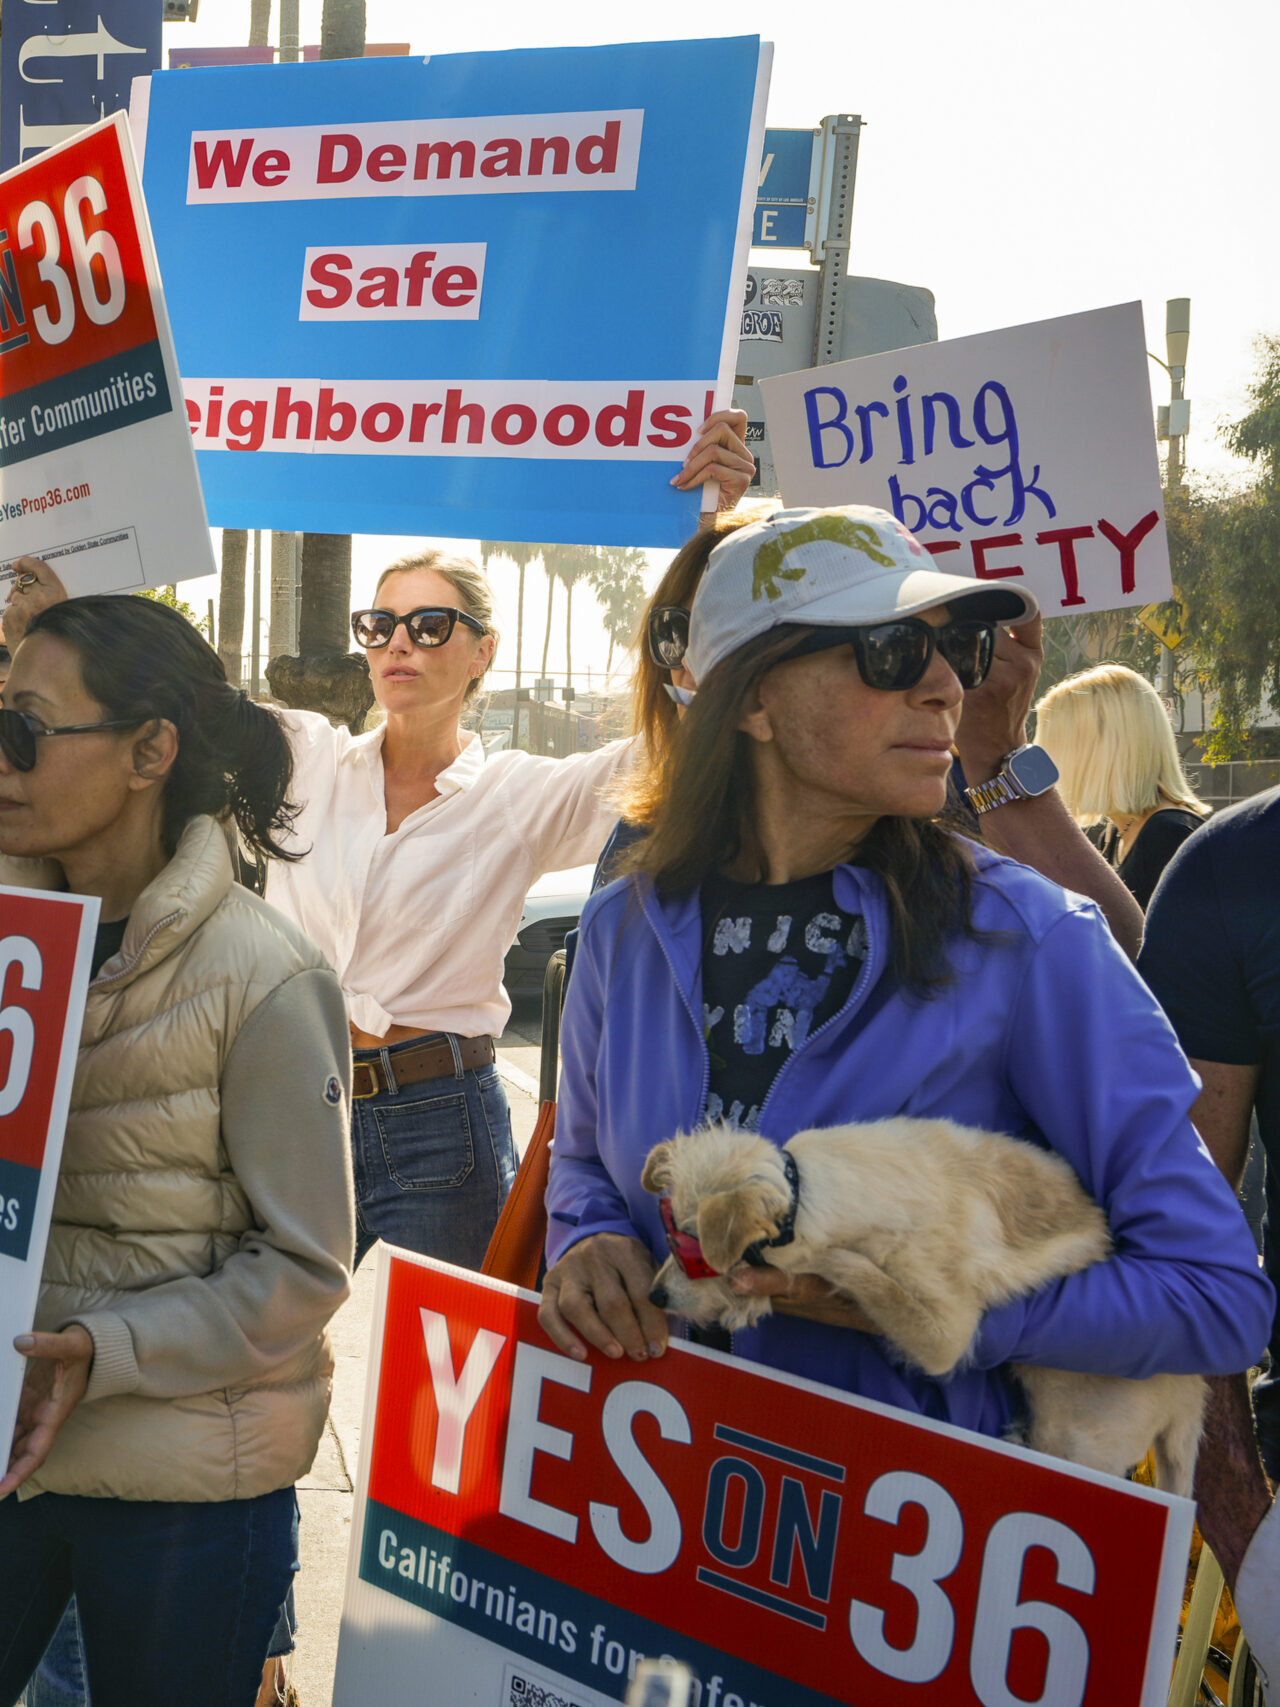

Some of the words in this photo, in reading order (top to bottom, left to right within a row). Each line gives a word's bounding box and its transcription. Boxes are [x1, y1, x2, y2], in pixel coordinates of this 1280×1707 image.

[193, 138, 291, 189] We
[316, 120, 622, 184] Demand
[18, 175, 126, 346] 36
[306, 251, 479, 309] Safe
[30, 372, 157, 437] Communities
[804, 375, 1019, 468] Bring
[888, 465, 1057, 533] back
[419, 1306, 693, 1575] YES
[701, 1455, 843, 1603] ON
[849, 1470, 1098, 1707] 36
[378, 1528, 577, 1654] Californians
[591, 1624, 645, 1681] for
